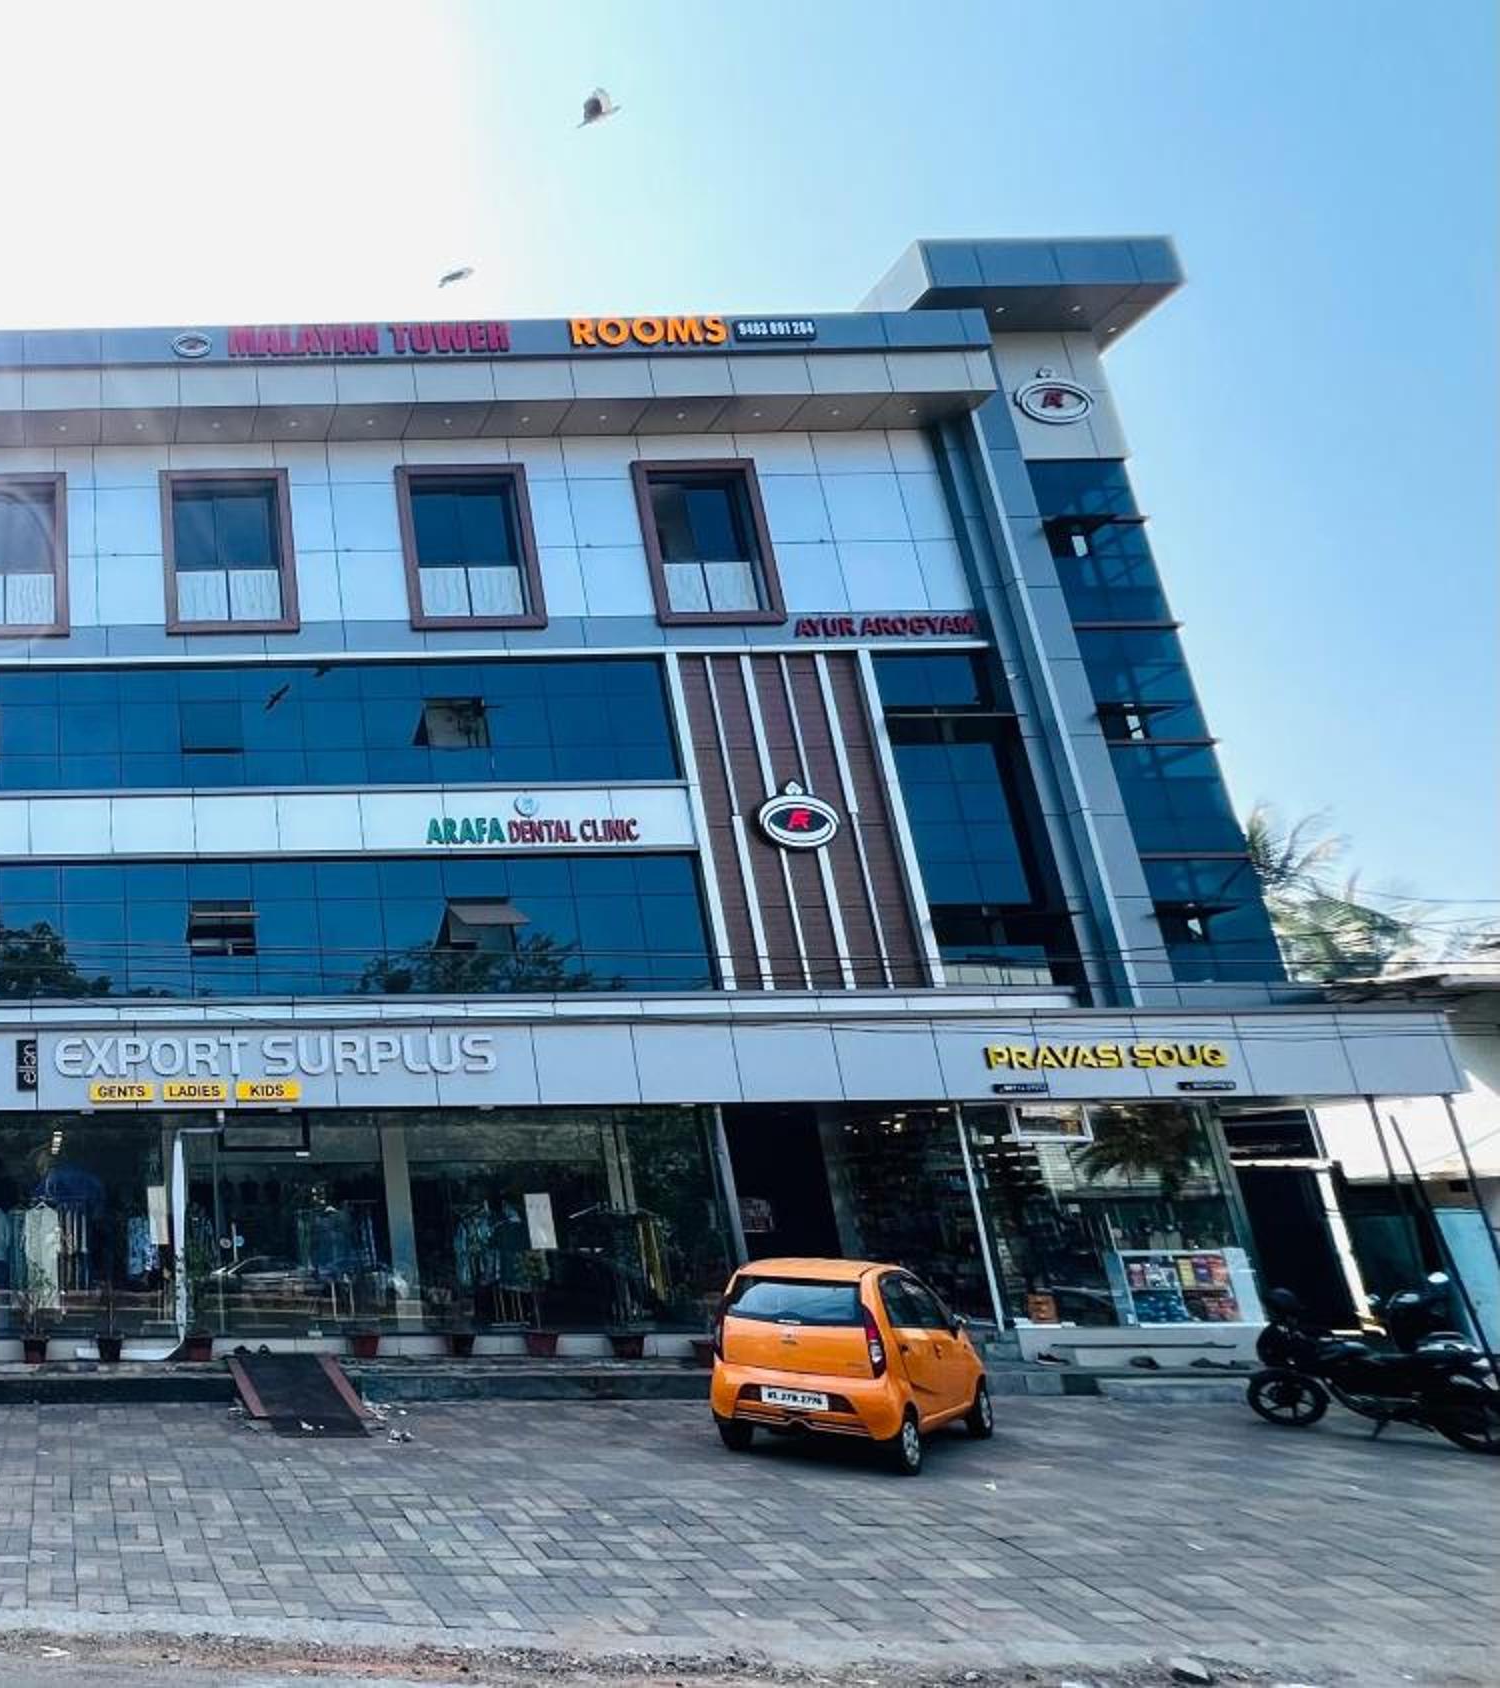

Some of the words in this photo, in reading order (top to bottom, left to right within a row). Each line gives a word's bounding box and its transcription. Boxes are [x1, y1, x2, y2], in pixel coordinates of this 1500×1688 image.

[228, 324, 379, 357] MALAYAN
[389, 321, 510, 354] TOWER
[568, 315, 729, 346] ROOMS
[794, 618, 855, 638] AYUR
[861, 615, 977, 637] AROGYAM
[426, 818, 506, 844] ARAFA
[507, 819, 577, 843] DENTAL
[580, 818, 641, 842] CLINIC
[53, 1035, 249, 1078] EXPORT
[261, 1034, 498, 1077] SURPLUS
[984, 1044, 1123, 1070] PRAVASI
[1130, 1042, 1228, 1069] SOUQ
[97, 1086, 146, 1098] GENTS
[169, 1085, 221, 1098] LADIES
[250, 1085, 285, 1097] KIDS
